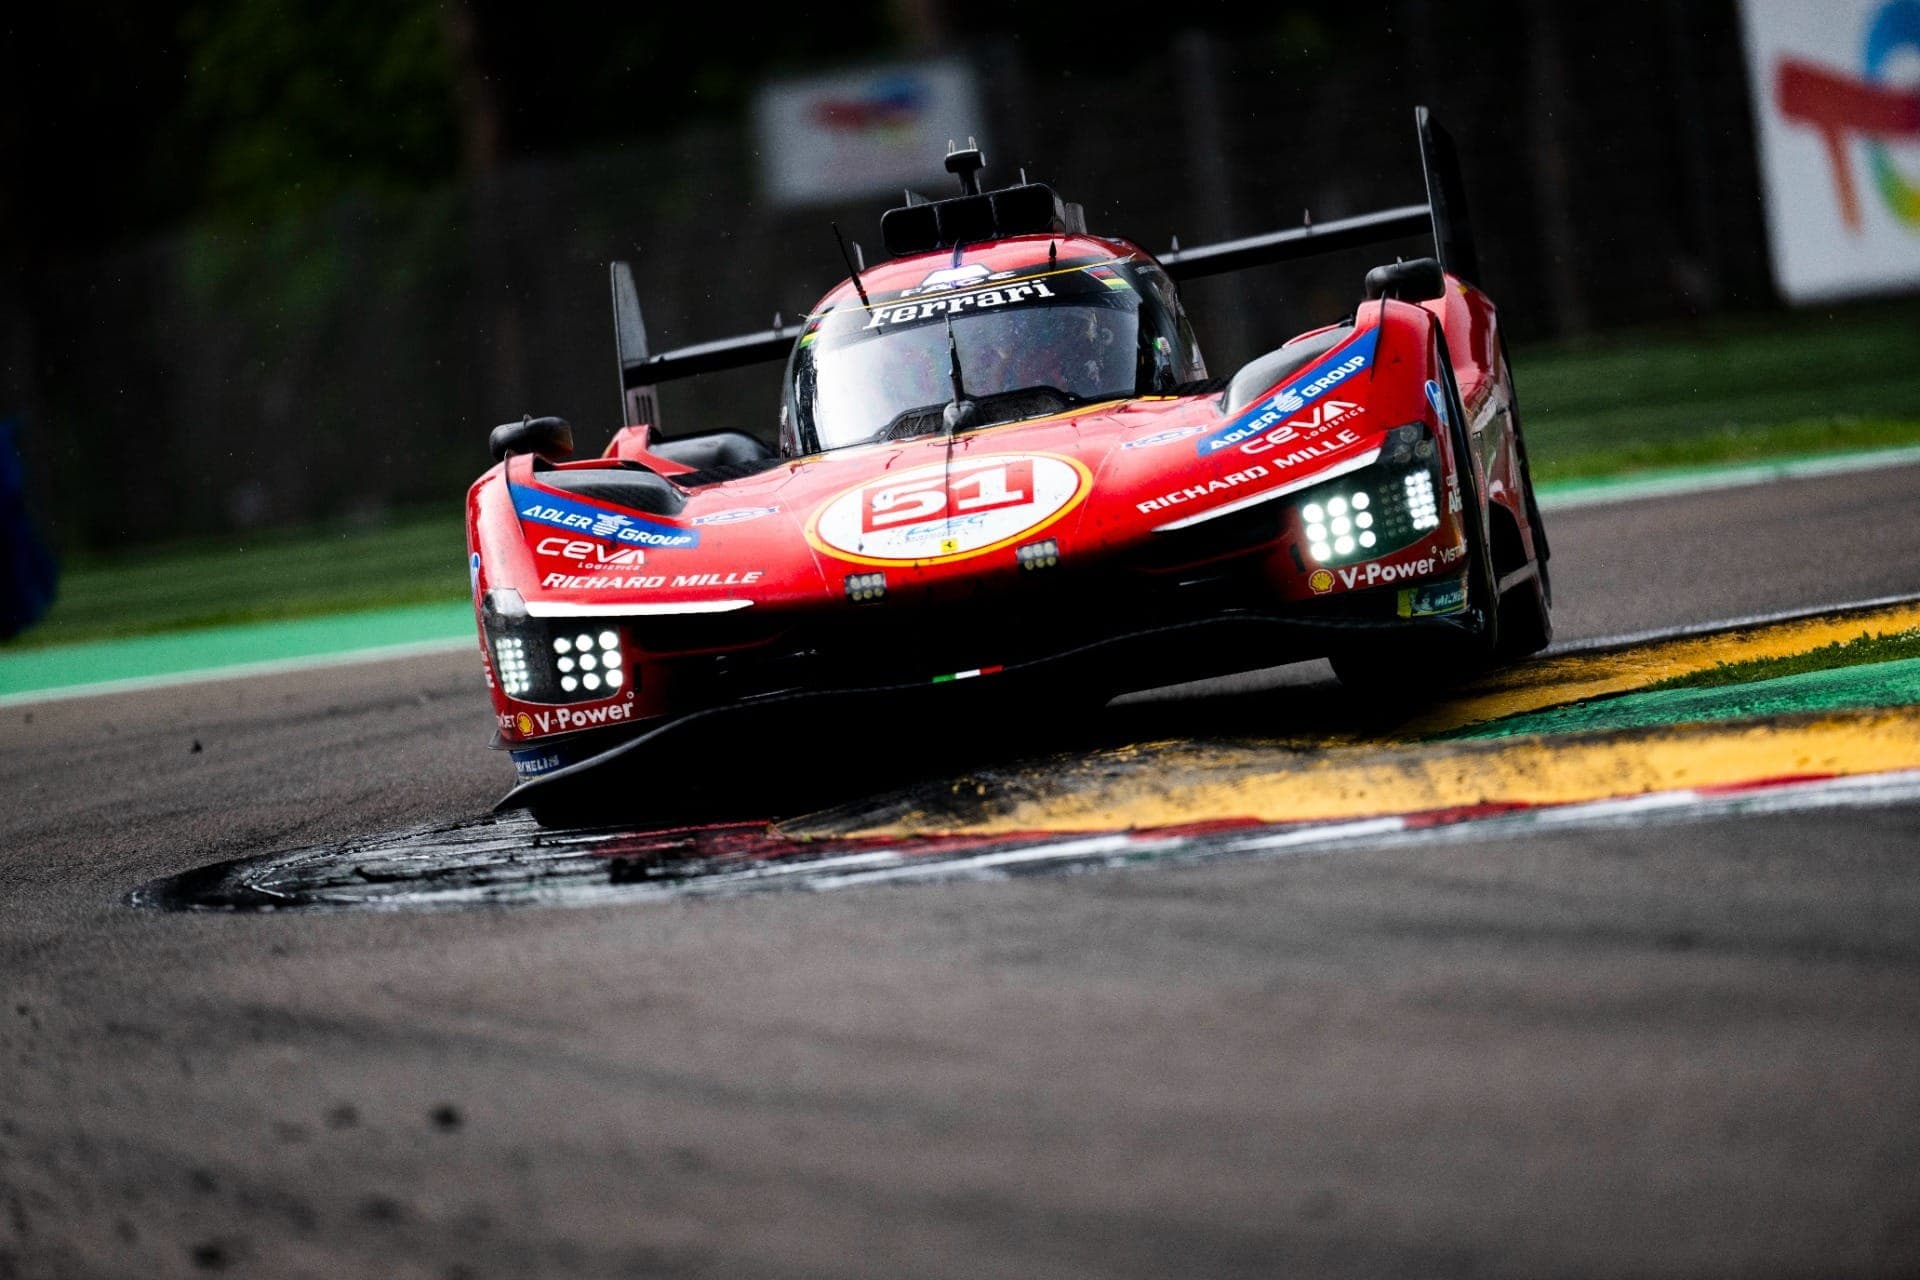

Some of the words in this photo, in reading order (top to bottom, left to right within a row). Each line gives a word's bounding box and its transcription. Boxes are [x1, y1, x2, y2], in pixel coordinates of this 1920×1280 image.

[863, 278, 1056, 330] Ferrari
[1210, 411, 1282, 450] ADLER
[1301, 356, 1365, 397] GROUP
[1303, 406, 1366, 440] LOGISTICS
[1136, 465, 1269, 514] RICHARD
[1272, 428, 1360, 469] MILLE
[869, 467, 1025, 526] 51
[522, 505, 593, 529] ADLER
[617, 528, 692, 546] GROUP
[541, 572, 667, 589] RICHARD
[669, 571, 762, 588] MILLE
[1338, 557, 1436, 589] V-Power
[534, 702, 634, 733] V-Power
